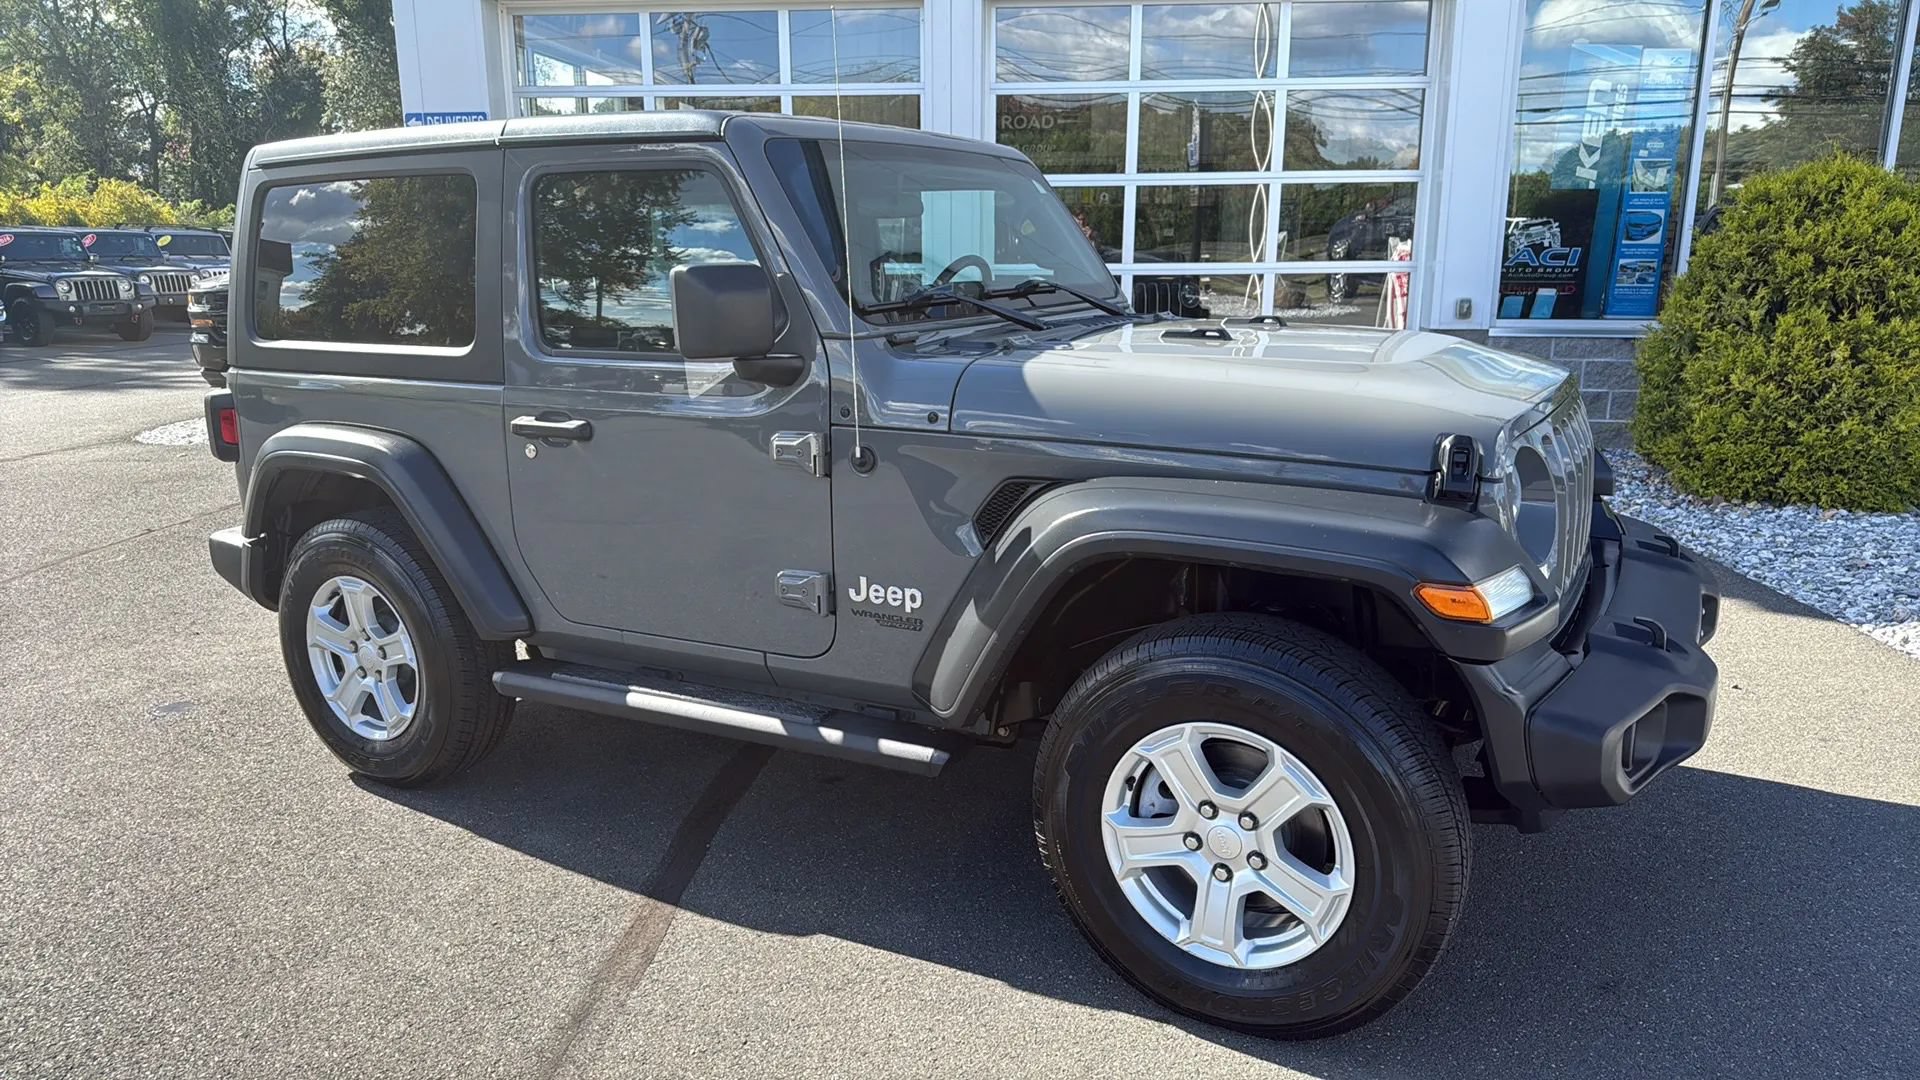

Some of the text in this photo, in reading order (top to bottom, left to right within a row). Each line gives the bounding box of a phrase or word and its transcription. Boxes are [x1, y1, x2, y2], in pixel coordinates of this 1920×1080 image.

[1001, 114, 1054, 129] ROAD
[1504, 247, 1582, 266] ACI
[848, 576, 922, 613] Jeep
[851, 609, 923, 625] WRANGLER
